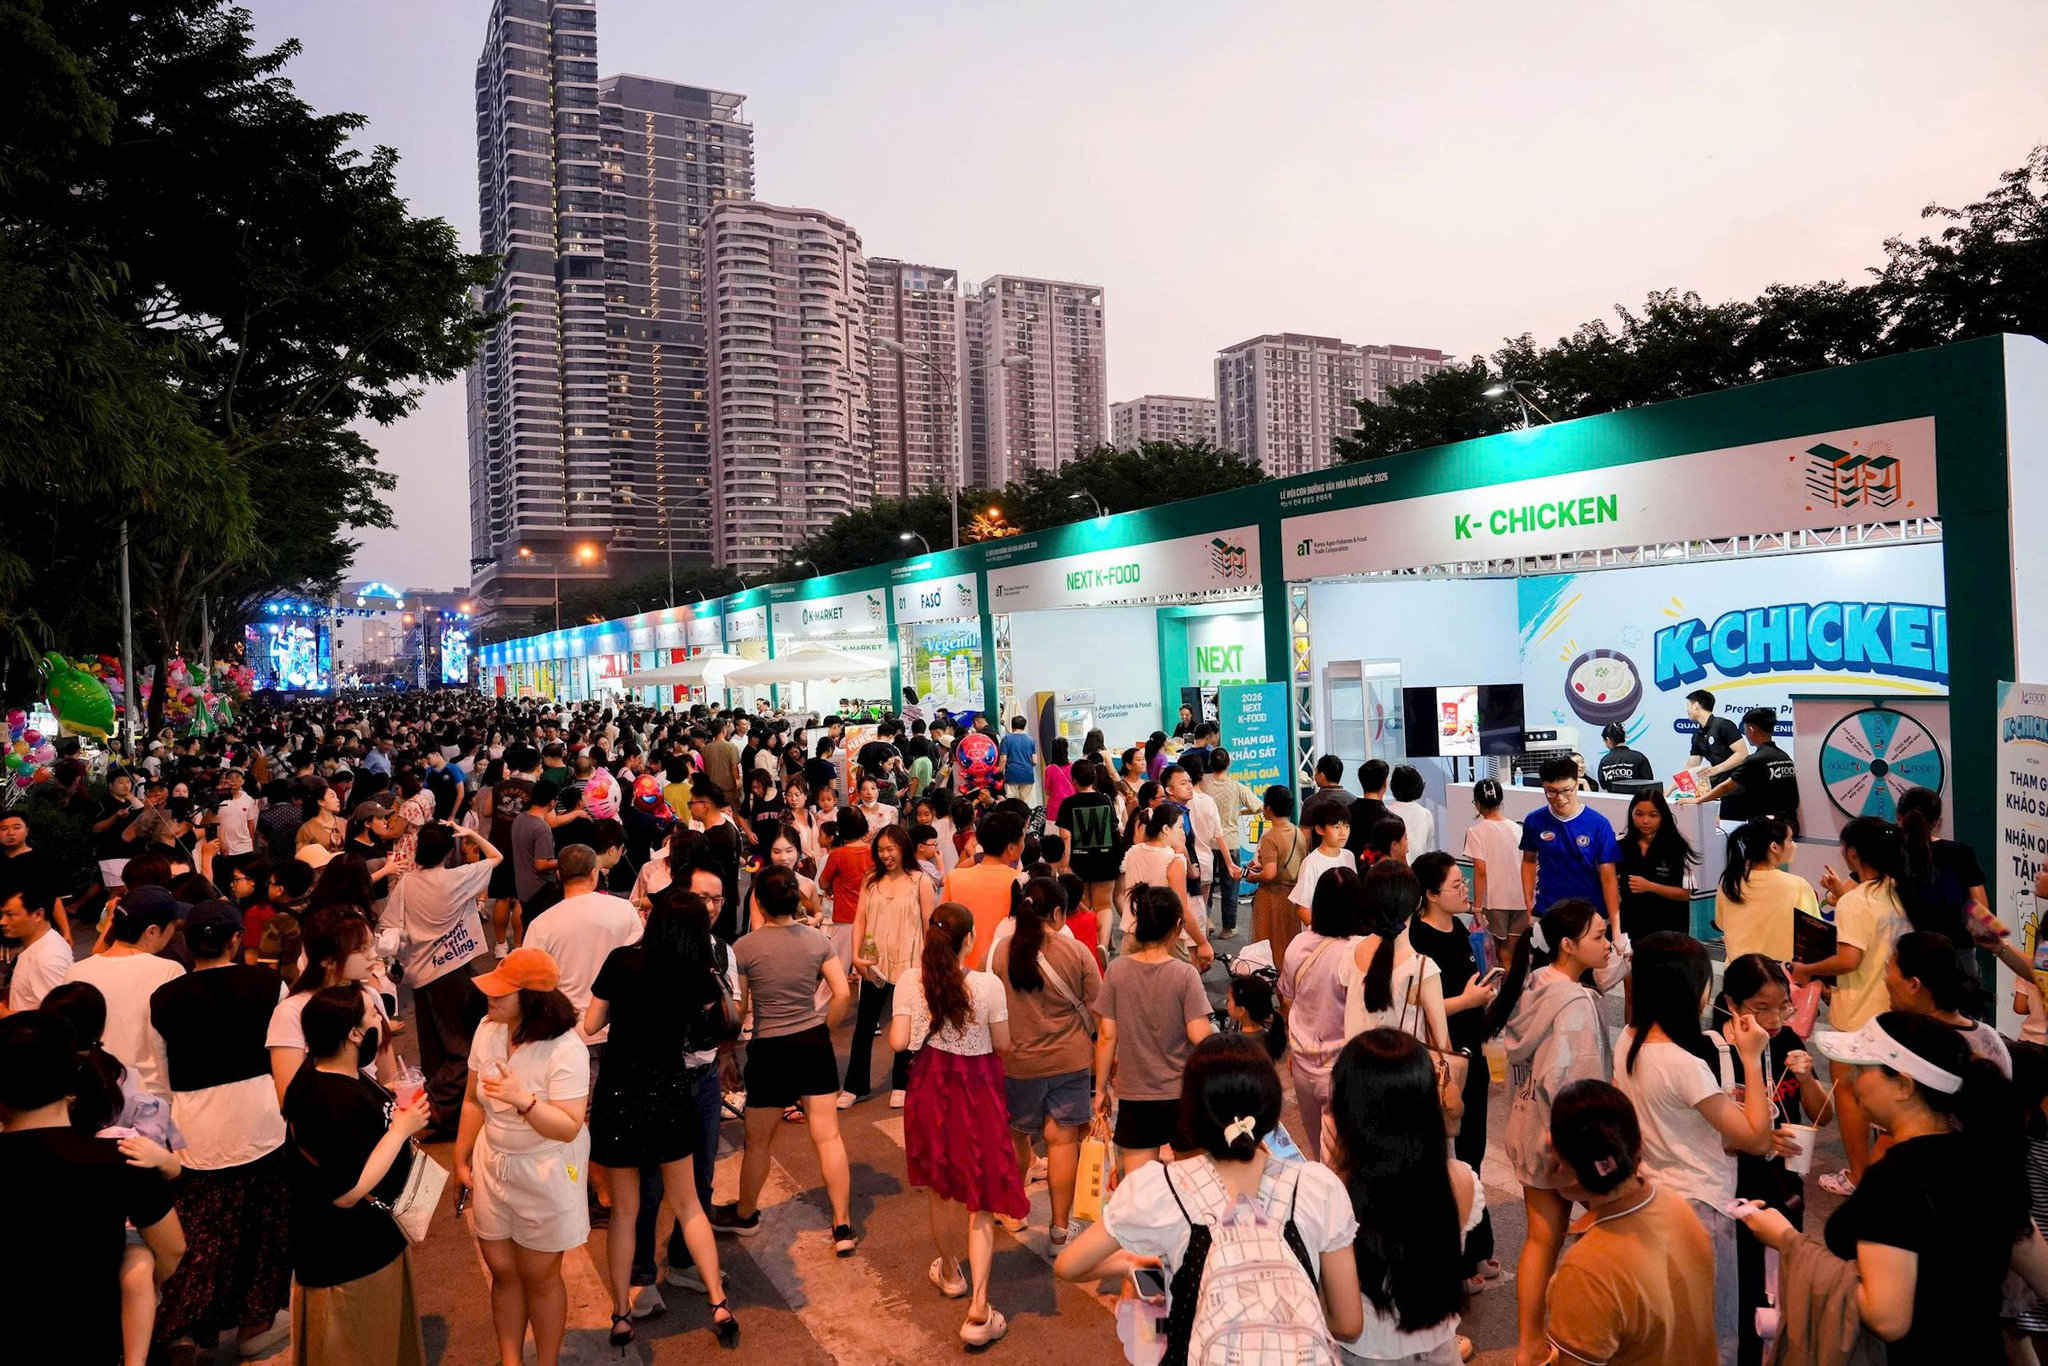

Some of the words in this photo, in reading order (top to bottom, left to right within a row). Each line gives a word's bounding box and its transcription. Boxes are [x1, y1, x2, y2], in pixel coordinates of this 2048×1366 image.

[1296, 487, 1307, 497] CON
[1374, 472, 1389, 484] 2026
[1489, 494, 1618, 536] CHICKEN
[1297, 538, 1313, 556] aT
[1066, 571, 1094, 591] NEXT
[1095, 563, 1141, 587] K-FOOD
[899, 597, 907, 610] 01
[808, 606, 844, 622] K-MARKET
[841, 644, 883, 652] K-MARKET
[924, 632, 978, 655] Vegemil
[1196, 645, 1244, 673] NEXT
[1241, 693, 1263, 703] 2026
[2029, 693, 2046, 703] FOOD
[1098, 711, 1128, 720] Corporation
[1099, 702, 1134, 713] Agro-Fisheries
[1242, 702, 1262, 713] NEXT
[1238, 713, 1267, 724] K-FOOD
[1232, 736, 1258, 747] THAM
[1259, 734, 1275, 744] GIA
[1229, 746, 1257, 761] KHẢO
[1258, 745, 1277, 759] SÁT
[2010, 771, 2037, 790] THAM
[2006, 791, 2036, 815] KHẢO
[1073, 806, 1112, 848] W
[2005, 828, 2035, 851] NHẬN
[432, 938, 478, 968] feeling.
